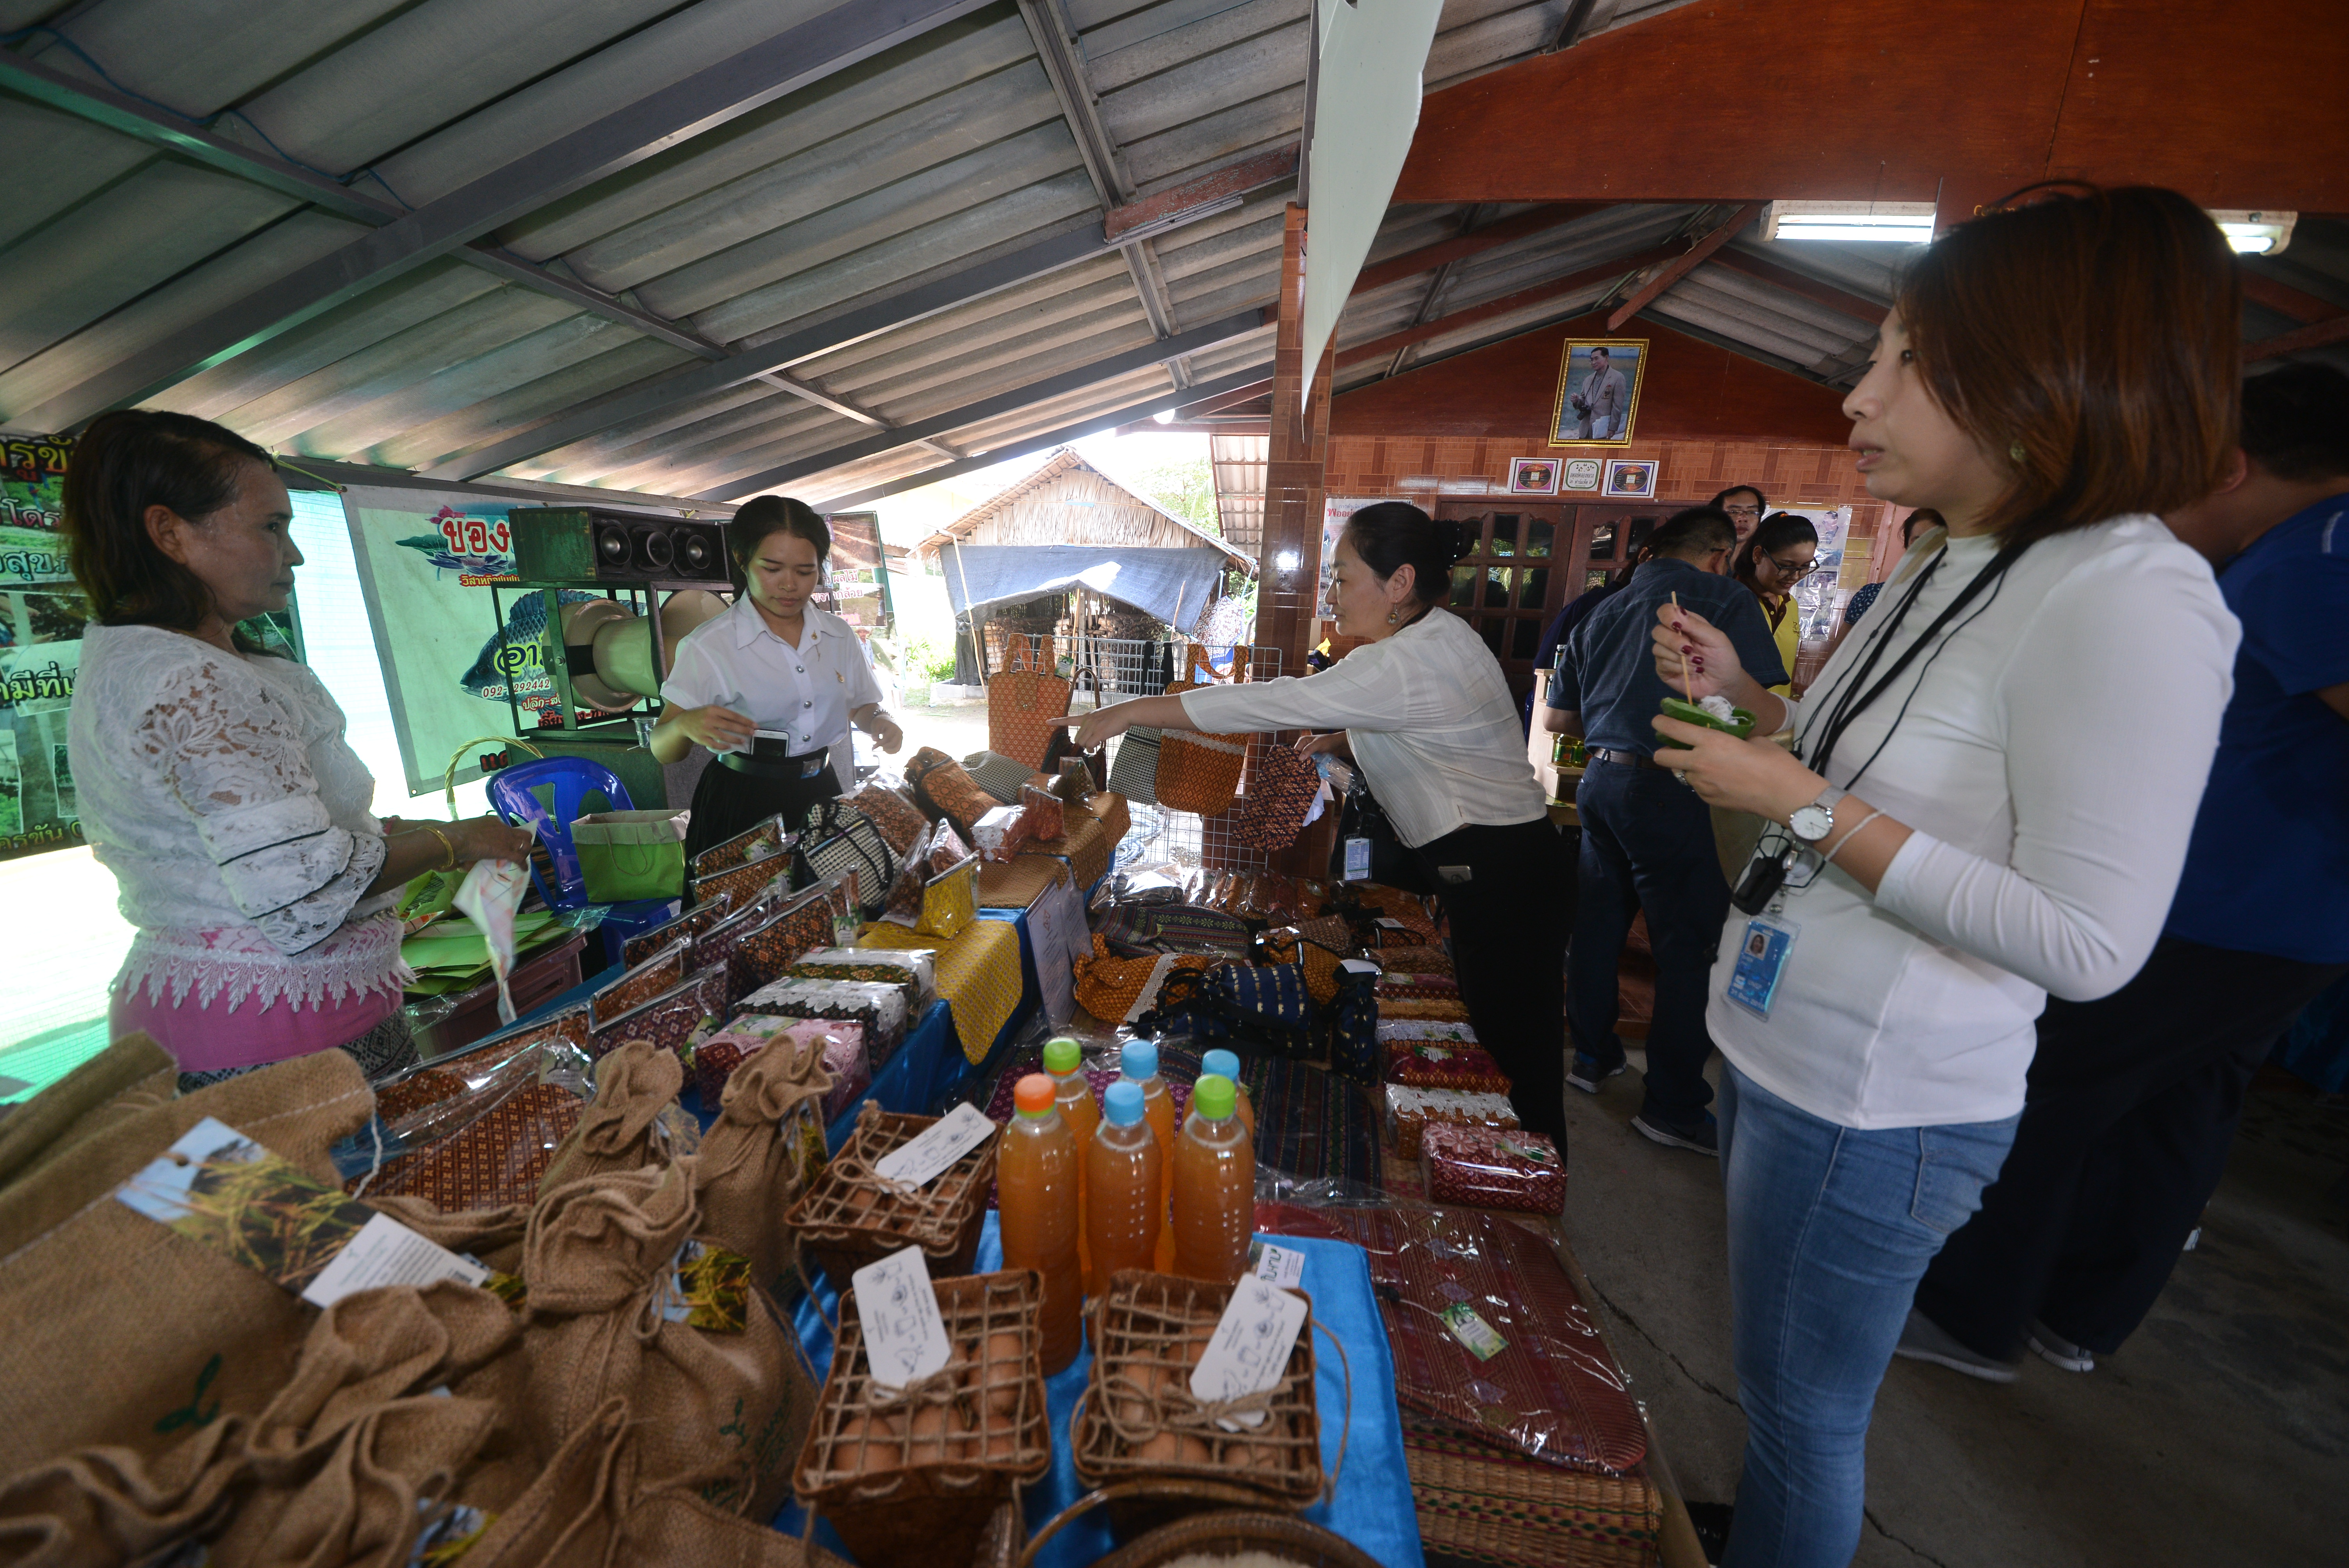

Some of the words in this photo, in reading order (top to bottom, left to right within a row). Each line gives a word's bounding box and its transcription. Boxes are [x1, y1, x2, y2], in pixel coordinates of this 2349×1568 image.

[1327, 508, 1356, 517] พออย่
[442, 520, 511, 553] ของ
[833, 570, 858, 582] ผลไม้
[483, 679, 550, 697] 092-292442
